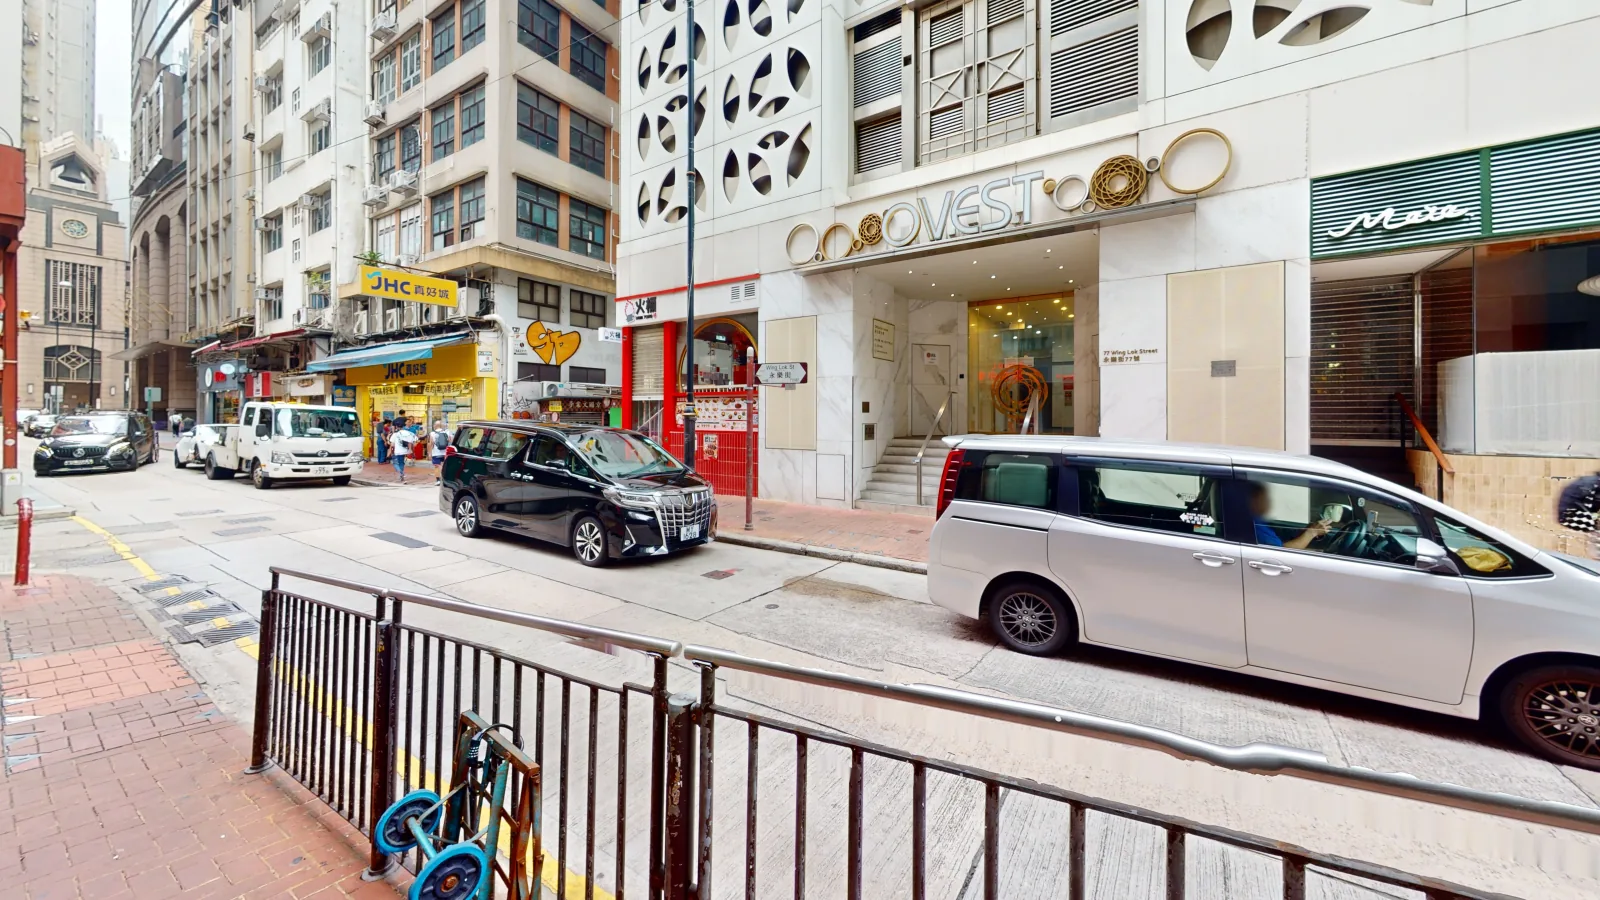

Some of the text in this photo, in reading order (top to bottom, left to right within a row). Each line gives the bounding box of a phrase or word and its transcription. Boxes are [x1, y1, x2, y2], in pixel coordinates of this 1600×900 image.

[882, 170, 1044, 247] OVEST
[371, 276, 410, 295] JHC
[414, 284, 450, 299] 真好城
[385, 362, 404, 379] JHC
[405, 362, 427, 376] 真好城
